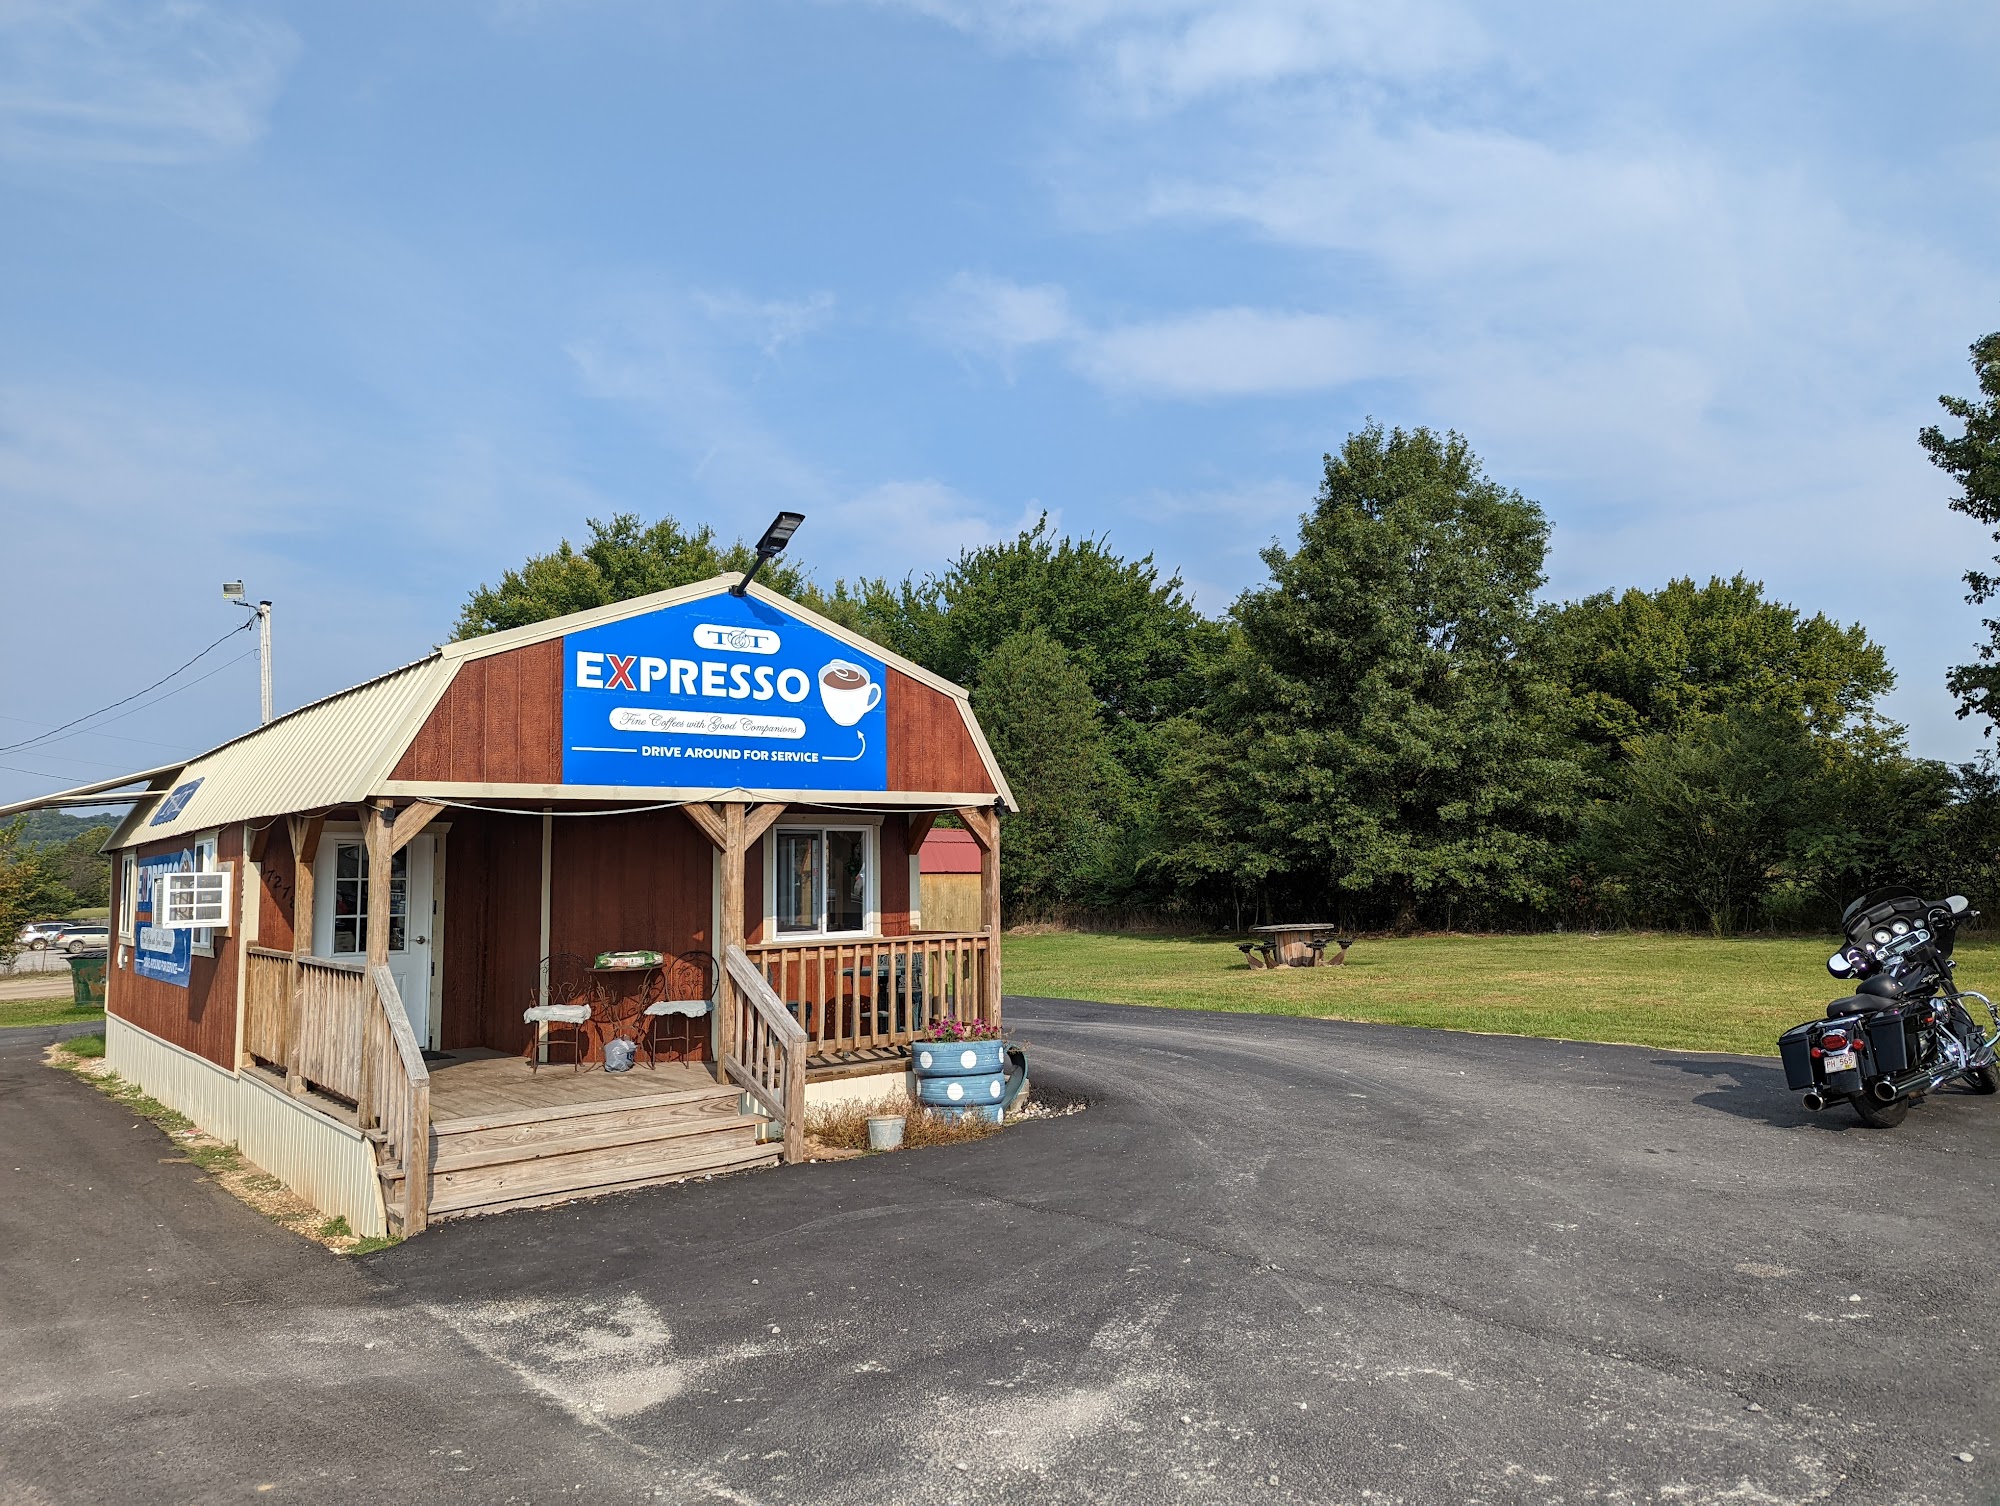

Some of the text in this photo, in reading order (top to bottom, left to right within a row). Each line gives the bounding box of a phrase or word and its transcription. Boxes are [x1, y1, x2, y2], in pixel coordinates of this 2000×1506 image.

[707, 629, 769, 649] T&T
[576, 651, 810, 703] EXPRESSO
[619, 711, 797, 737] Fine Coffees with Good Companions
[642, 746, 818, 763] DRIVE AROUND FOR SERVICE
